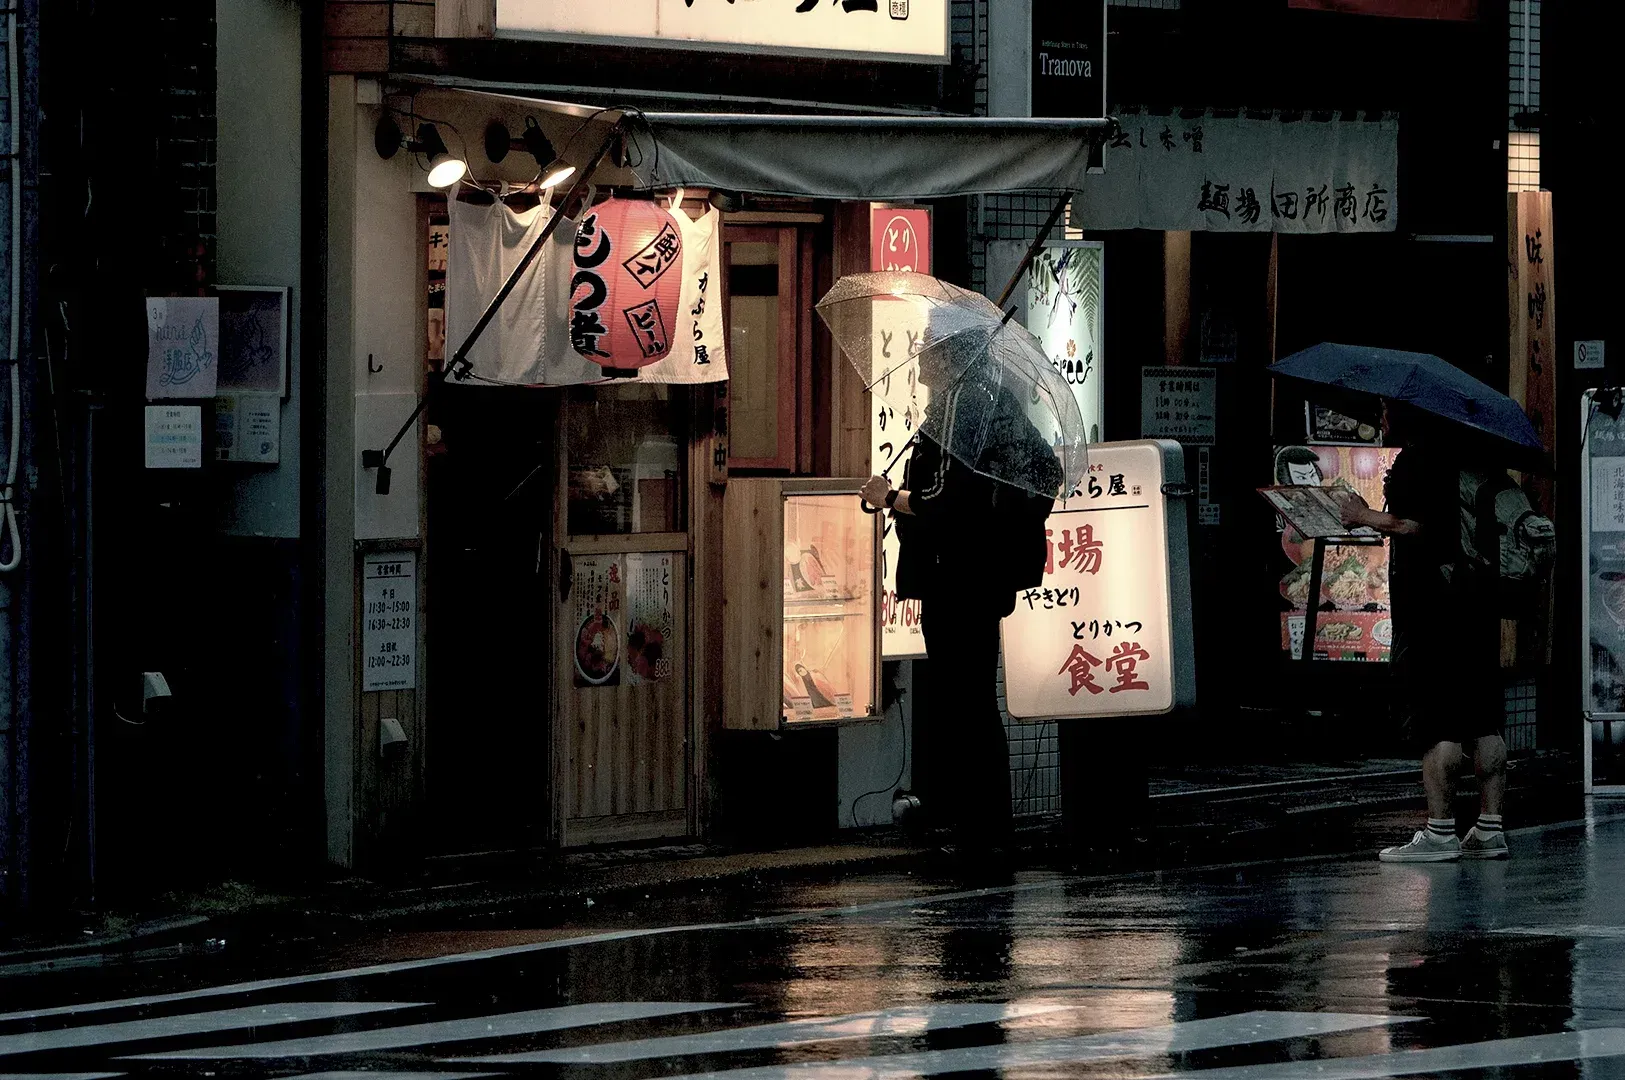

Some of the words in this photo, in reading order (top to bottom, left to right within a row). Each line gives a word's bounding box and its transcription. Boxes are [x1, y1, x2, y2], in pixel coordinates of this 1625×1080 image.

[1039, 52, 1092, 77] Tranova
[570, 213, 611, 358] もつ煮
[632, 305, 665, 354] ビール
[377, 564, 402, 575] 営業時間
[382, 588, 395, 600] 平日
[609, 563, 621, 611] 逸品
[1022, 586, 1080, 611] やきとり
[661, 568, 671, 639] とりかつ
[1071, 618, 1142, 640] とりかつ
[380, 642, 398, 653] 土日祝
[1058, 641, 1150, 696] 食堂
